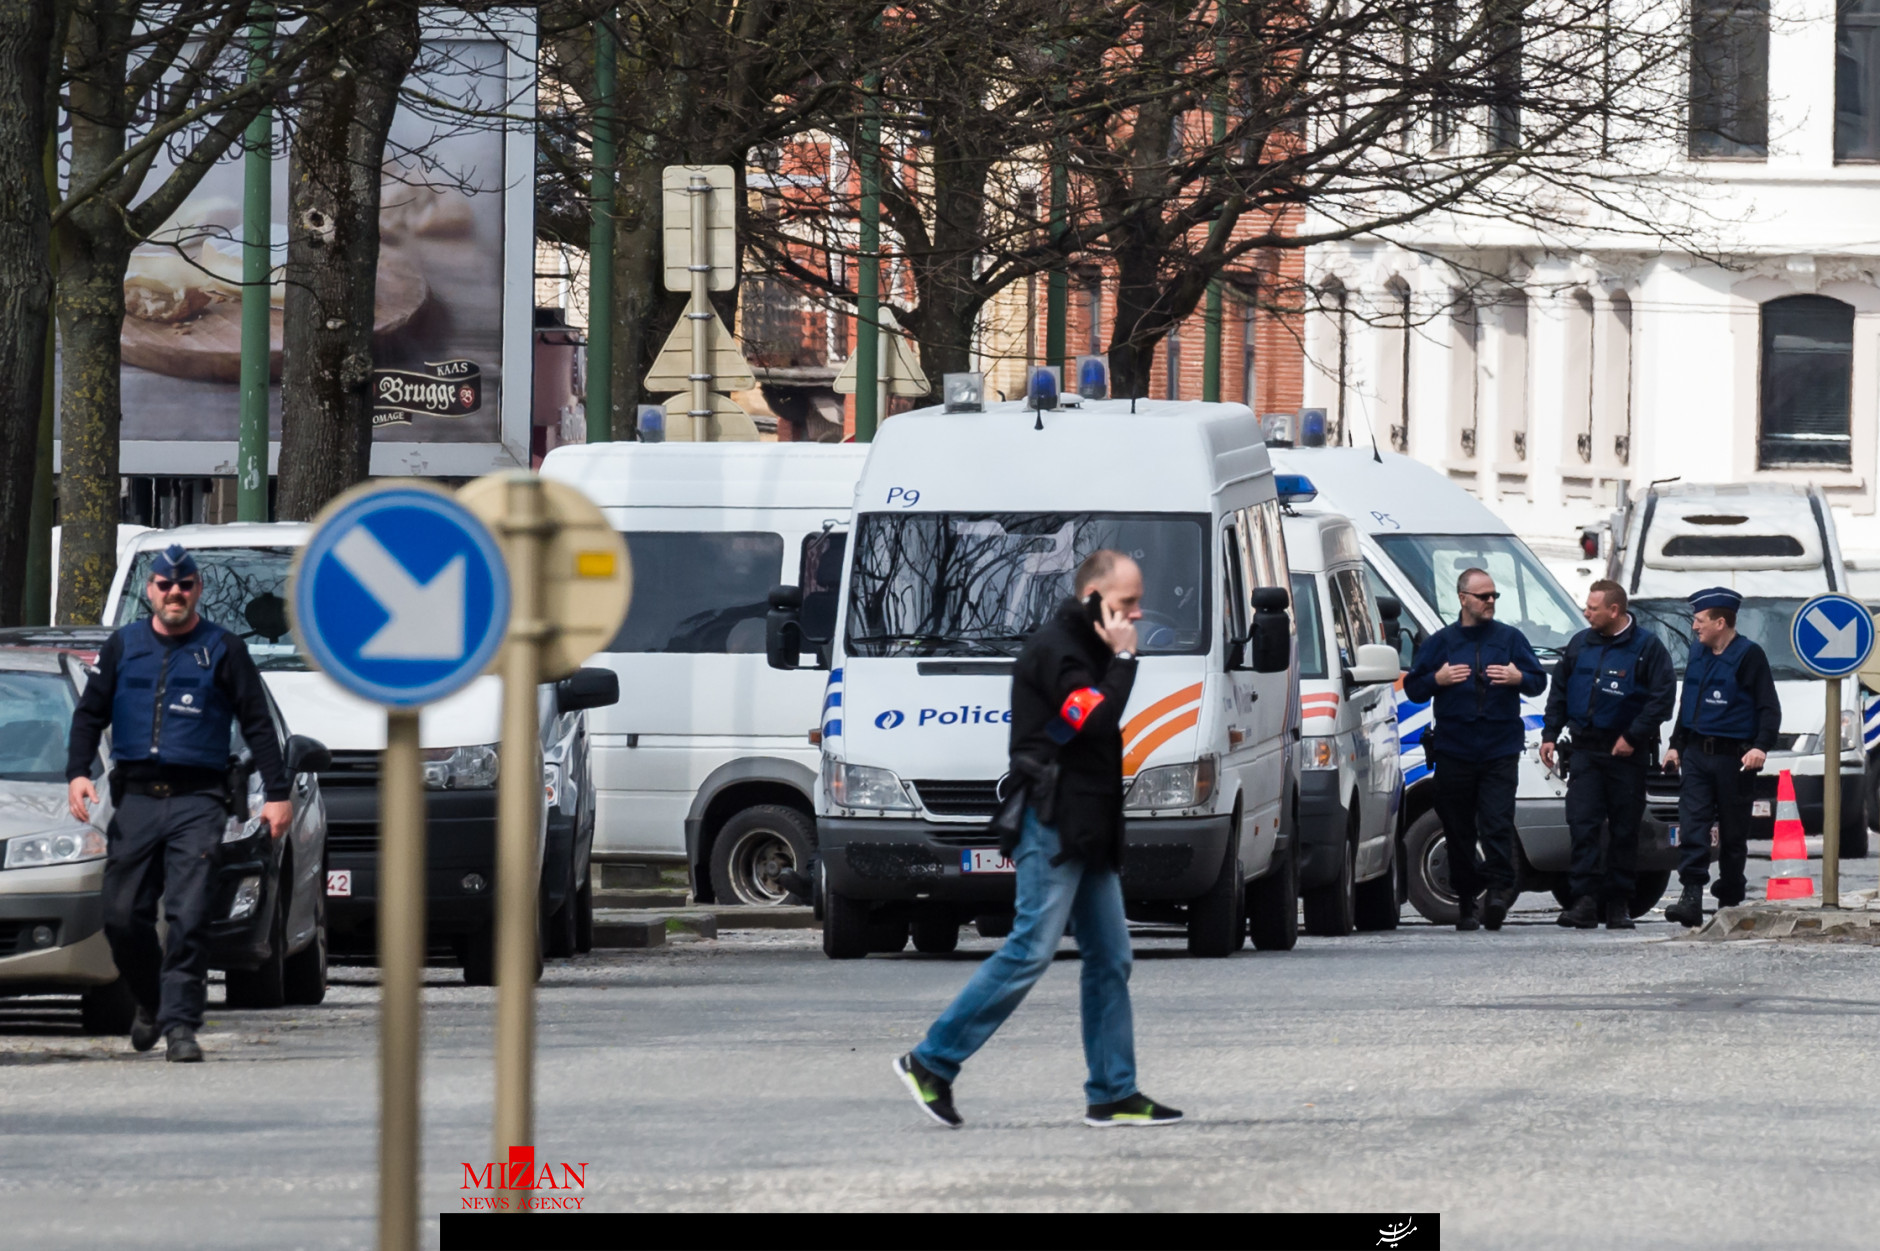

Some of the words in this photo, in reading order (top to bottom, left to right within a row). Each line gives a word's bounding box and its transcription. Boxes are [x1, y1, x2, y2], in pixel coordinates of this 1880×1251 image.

[437, 363, 468, 376] KAAS
[379, 376, 457, 410] Brugge
[372, 411, 405, 424] OMAGE
[886, 486, 921, 508] P9
[1370, 510, 1401, 530] P5
